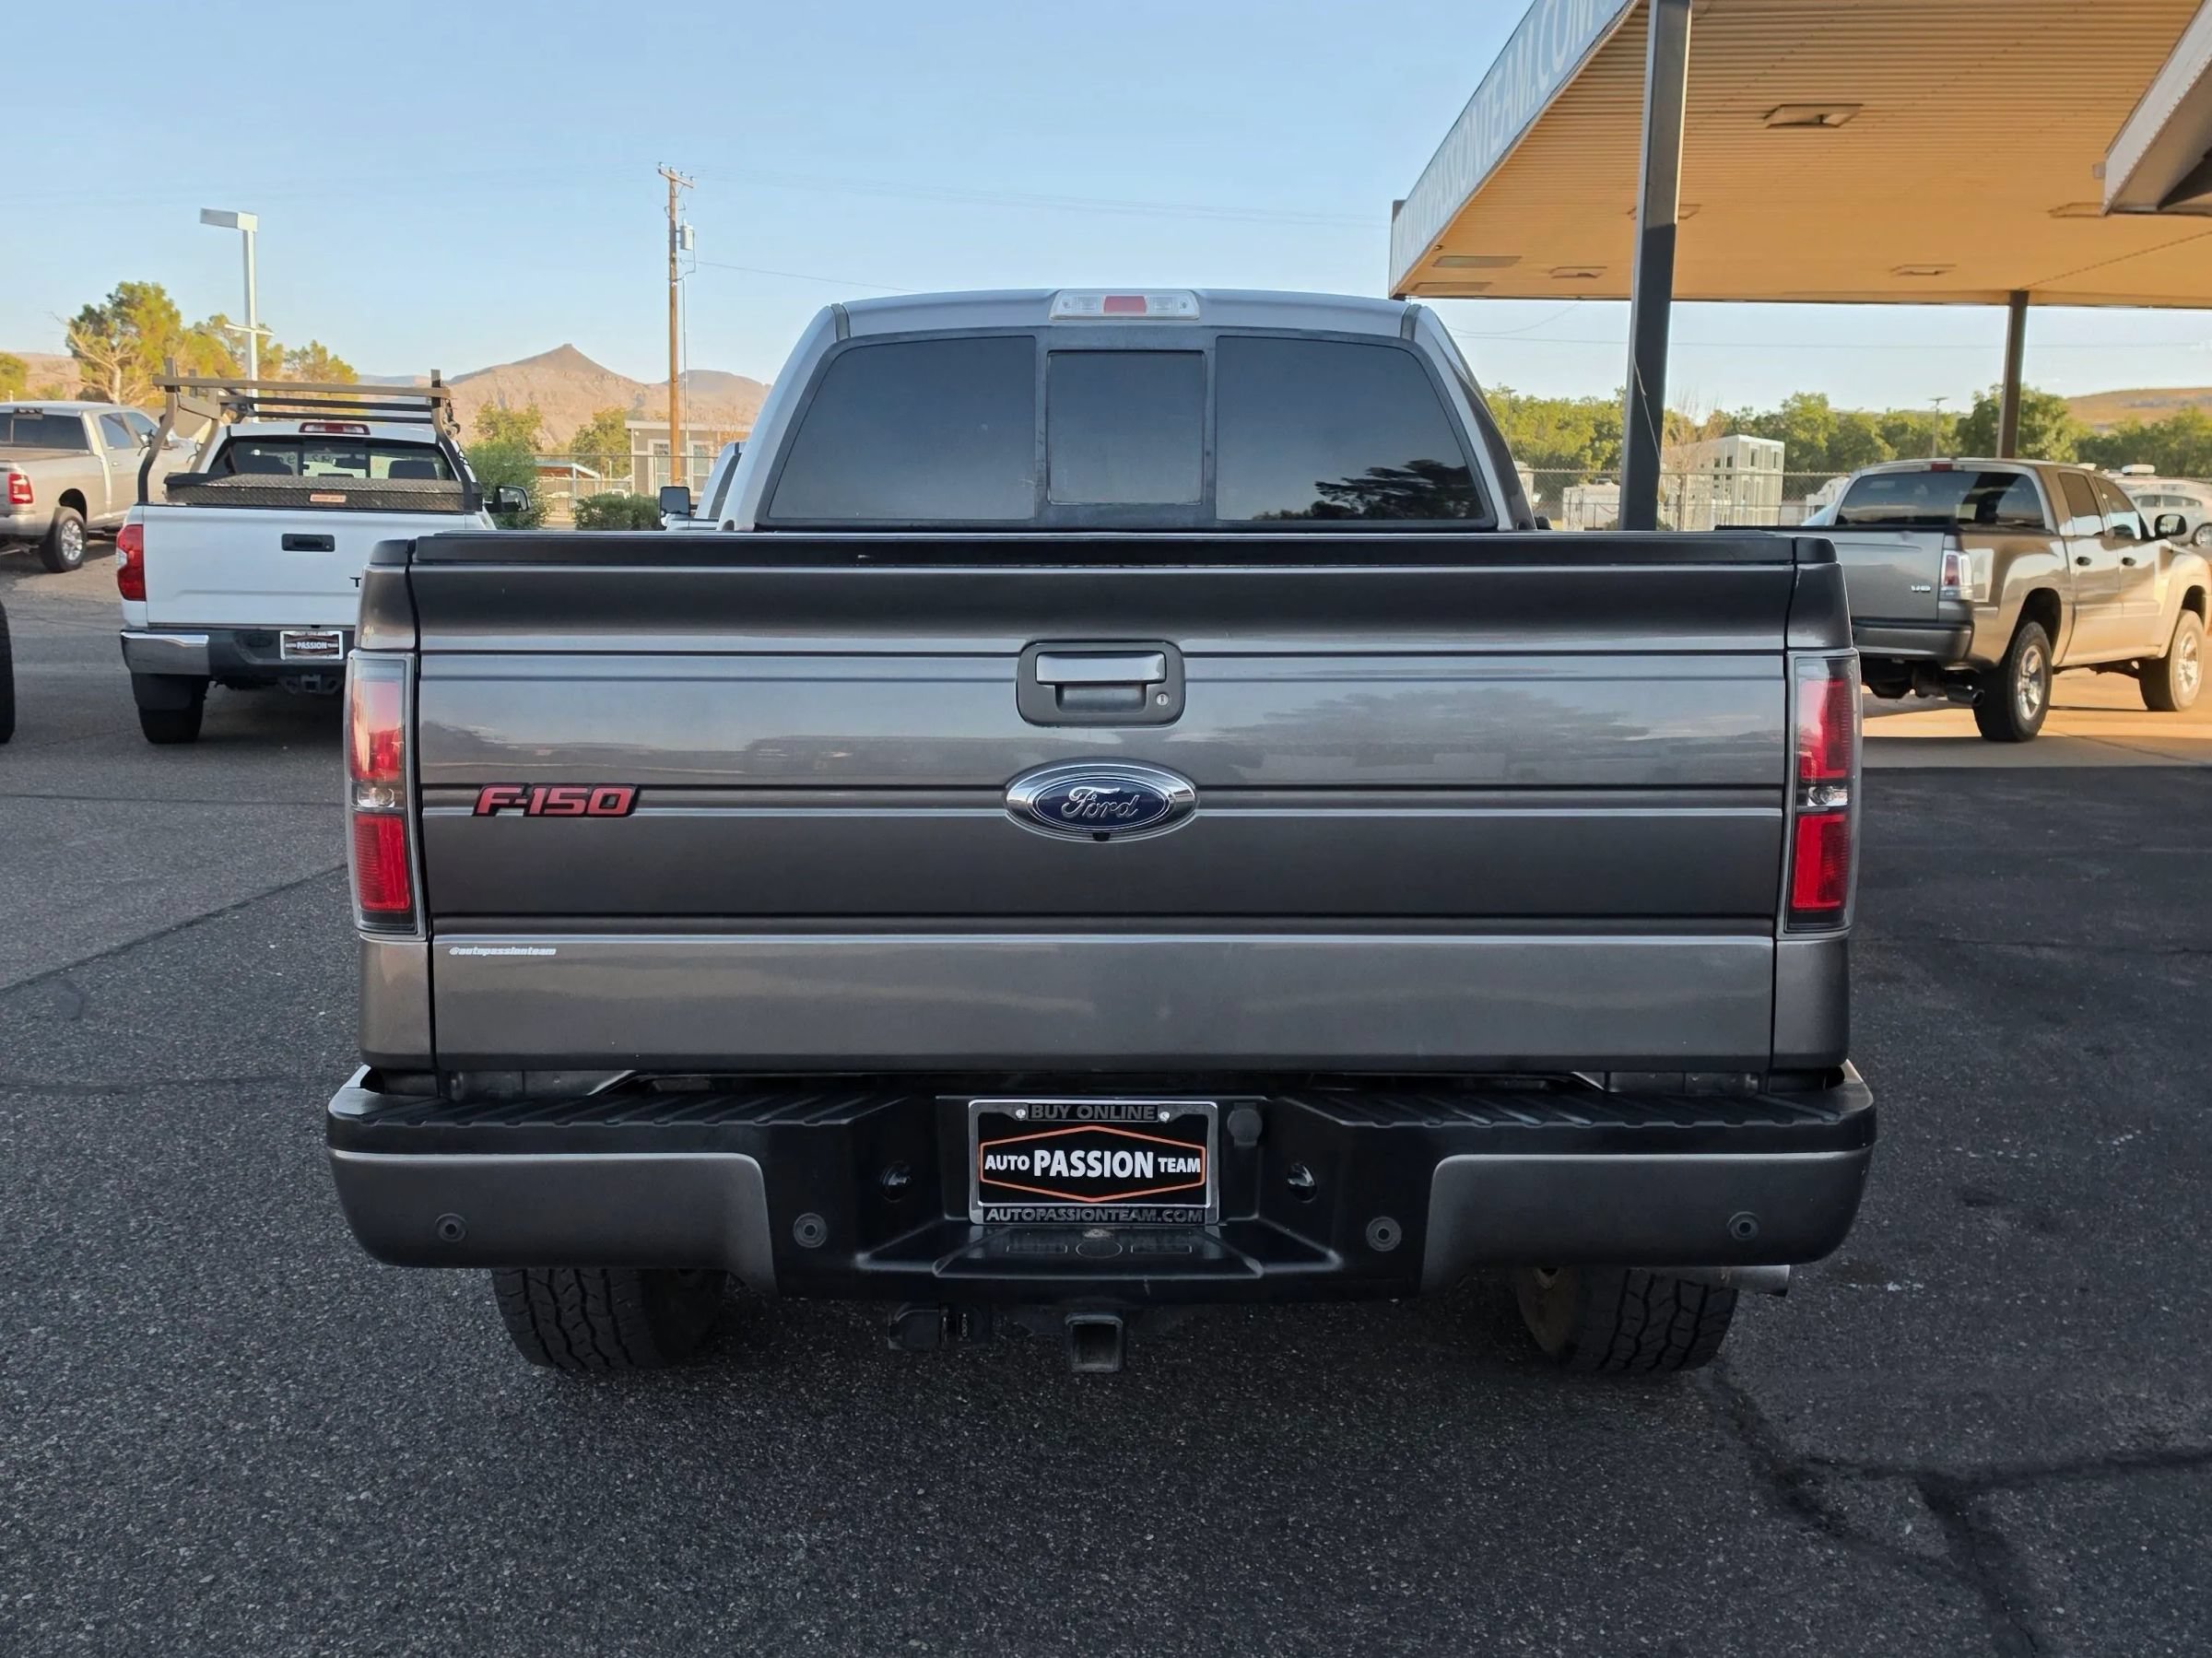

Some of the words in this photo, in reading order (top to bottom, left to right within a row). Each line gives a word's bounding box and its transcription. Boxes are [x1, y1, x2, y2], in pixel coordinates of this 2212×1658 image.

[475, 786, 634, 817] F-150
[1061, 785, 1140, 818] Ford
[449, 947, 557, 956] @autopassionteam
[1028, 1105, 1072, 1120] BUY
[1077, 1105, 1156, 1121] ONLINE
[984, 1154, 1030, 1170] AUTO
[1033, 1149, 1154, 1178] PASSION
[1158, 1157, 1201, 1173] TEAM
[986, 1207, 1204, 1222] AUTOPASSIONTEAM.COM
